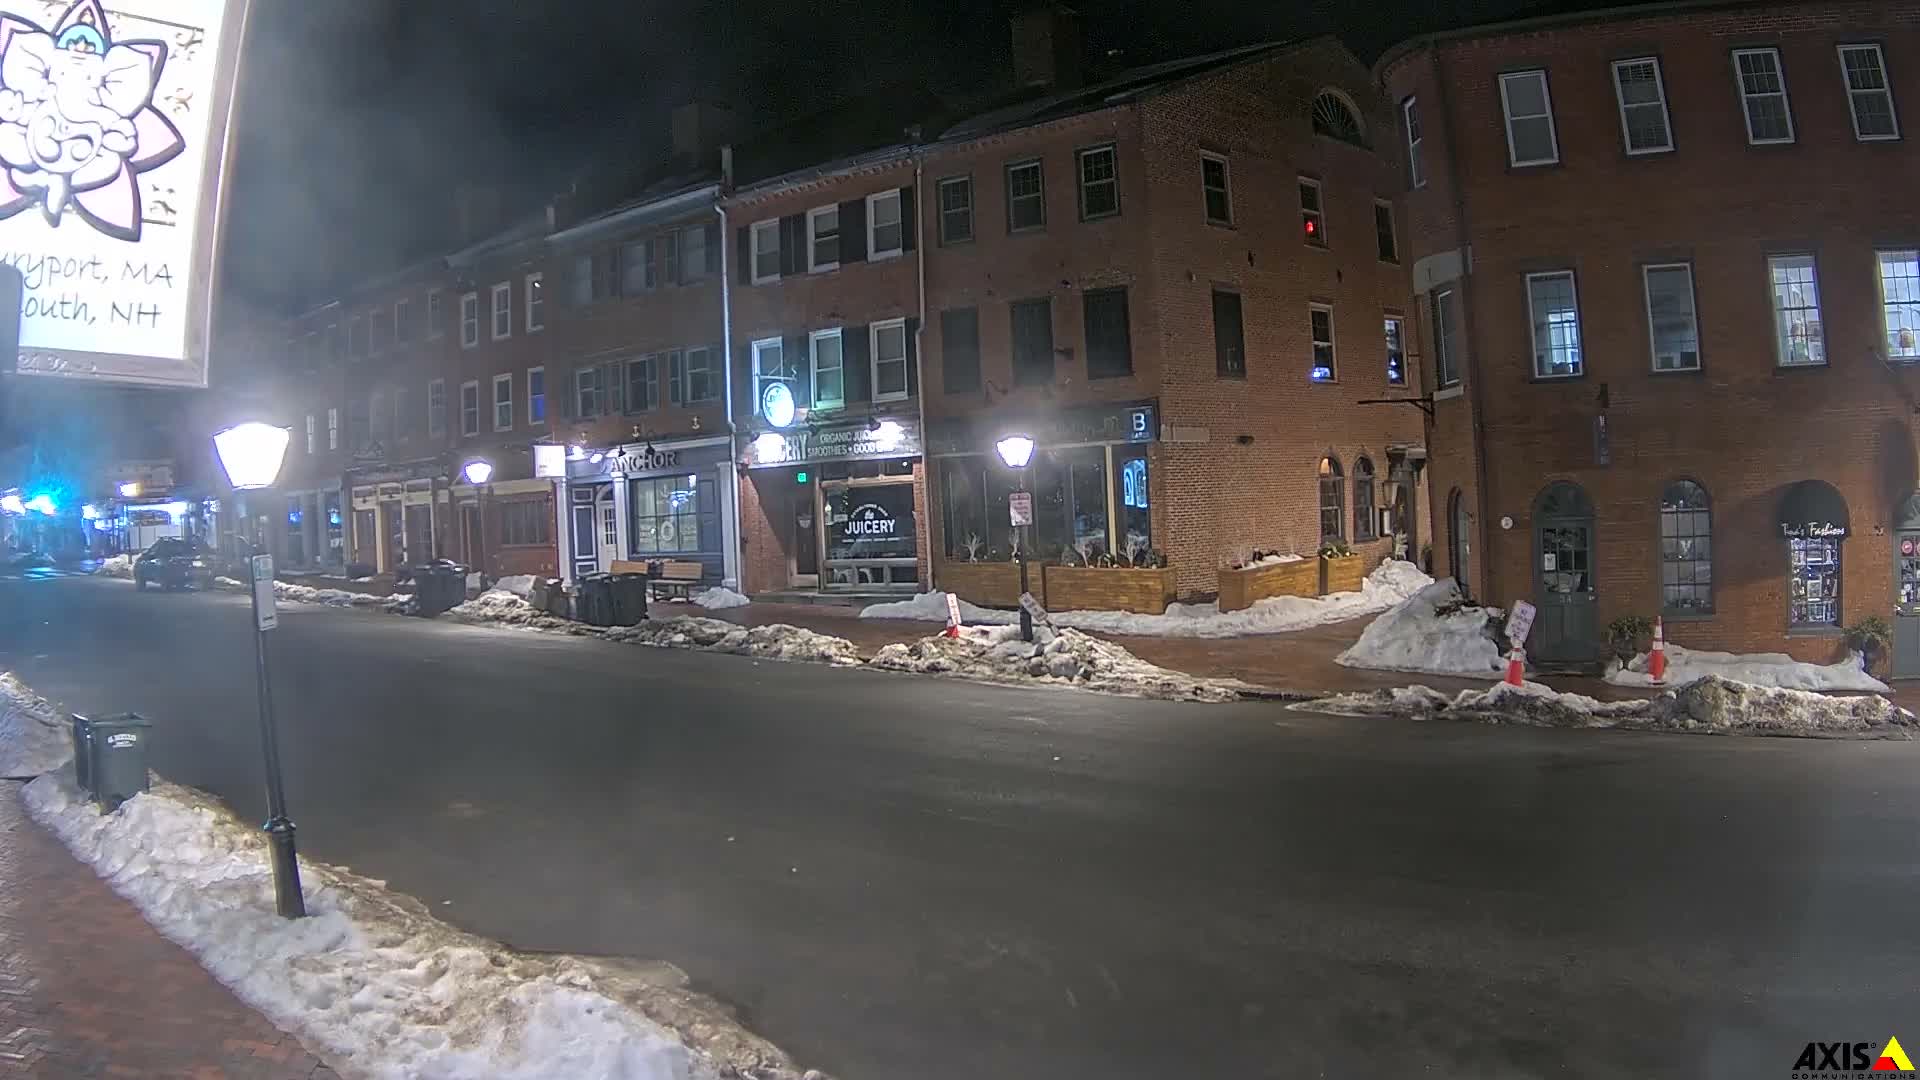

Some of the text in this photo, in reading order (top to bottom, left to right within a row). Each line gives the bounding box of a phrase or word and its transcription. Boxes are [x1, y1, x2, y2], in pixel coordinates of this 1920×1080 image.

[121, 260, 173, 288] MA
[110, 301, 161, 329] NH
[819, 431, 851, 444] ORGANIC
[808, 444, 848, 457] SMOOTHIES
[611, 450, 678, 473] ANCHOR
[845, 519, 895, 534] JUICERY
